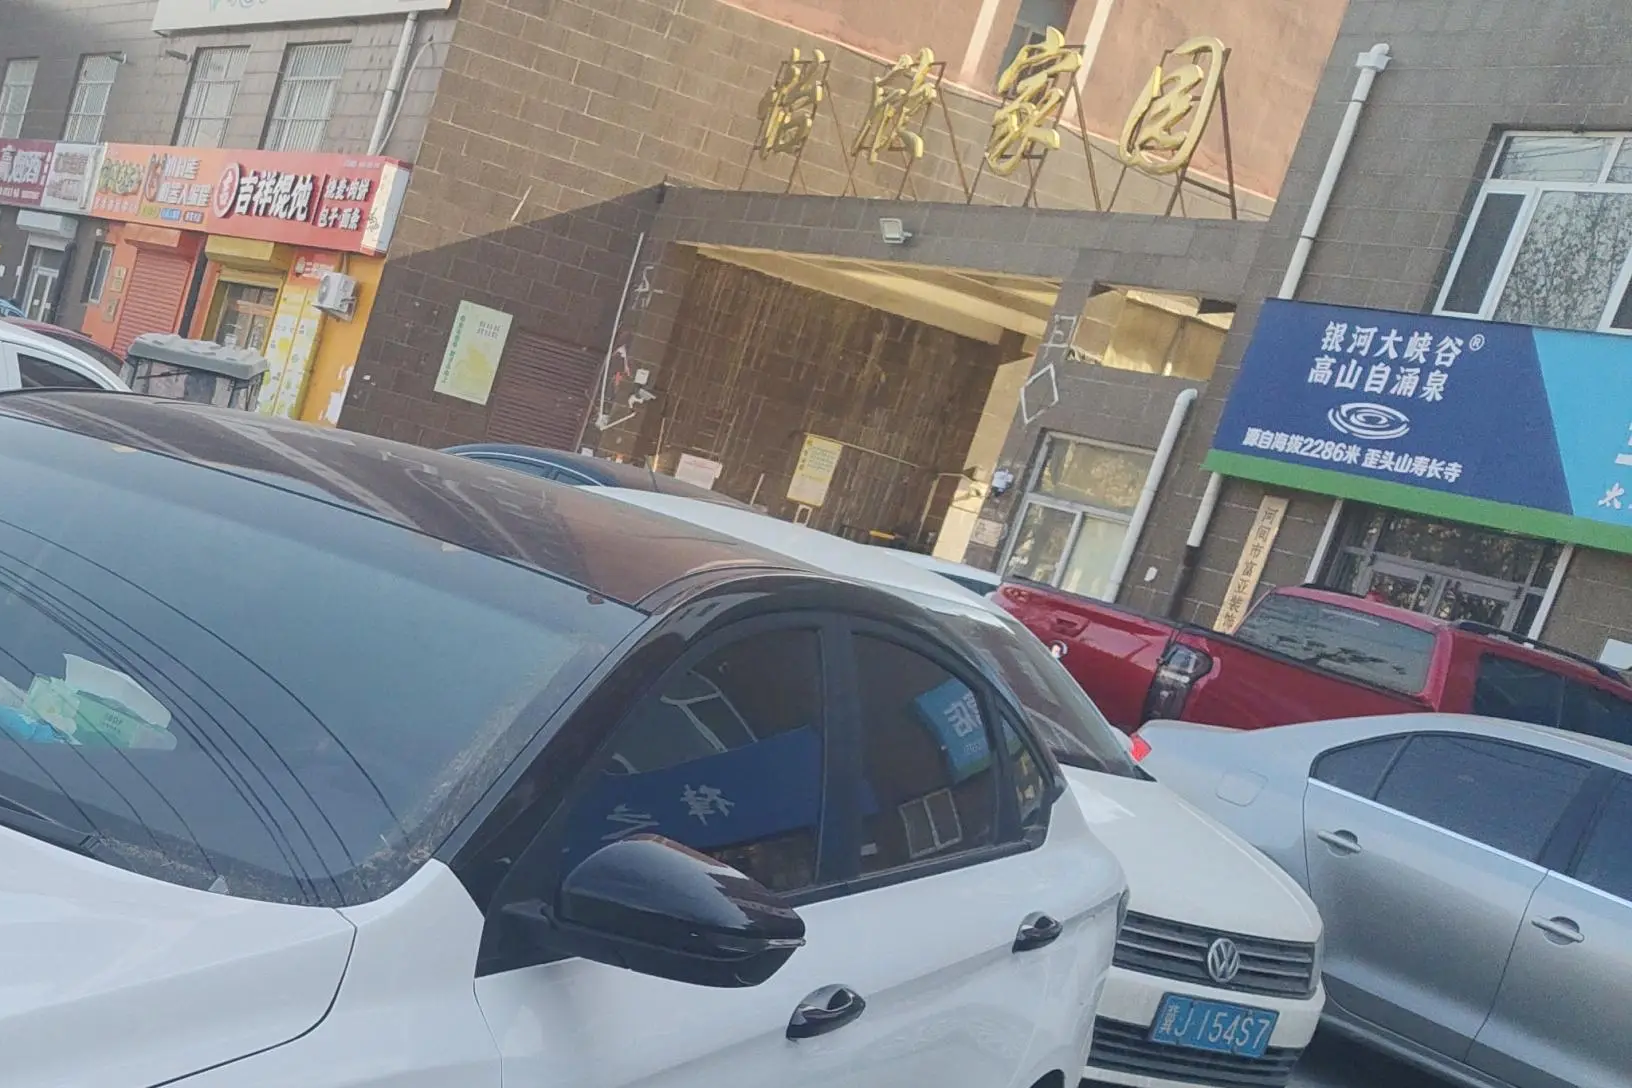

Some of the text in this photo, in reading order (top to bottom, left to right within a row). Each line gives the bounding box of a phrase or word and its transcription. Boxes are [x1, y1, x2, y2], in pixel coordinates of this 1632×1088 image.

[234, 169, 313, 222] 吉祥馄饨
[1321, 320, 1464, 368] 银河大峡谷
[1308, 354, 1449, 402] 高山自涌泉
[1242, 427, 1362, 465] 源自海拔2286米
[1361, 447, 1464, 483] 歪头山寿长寺
